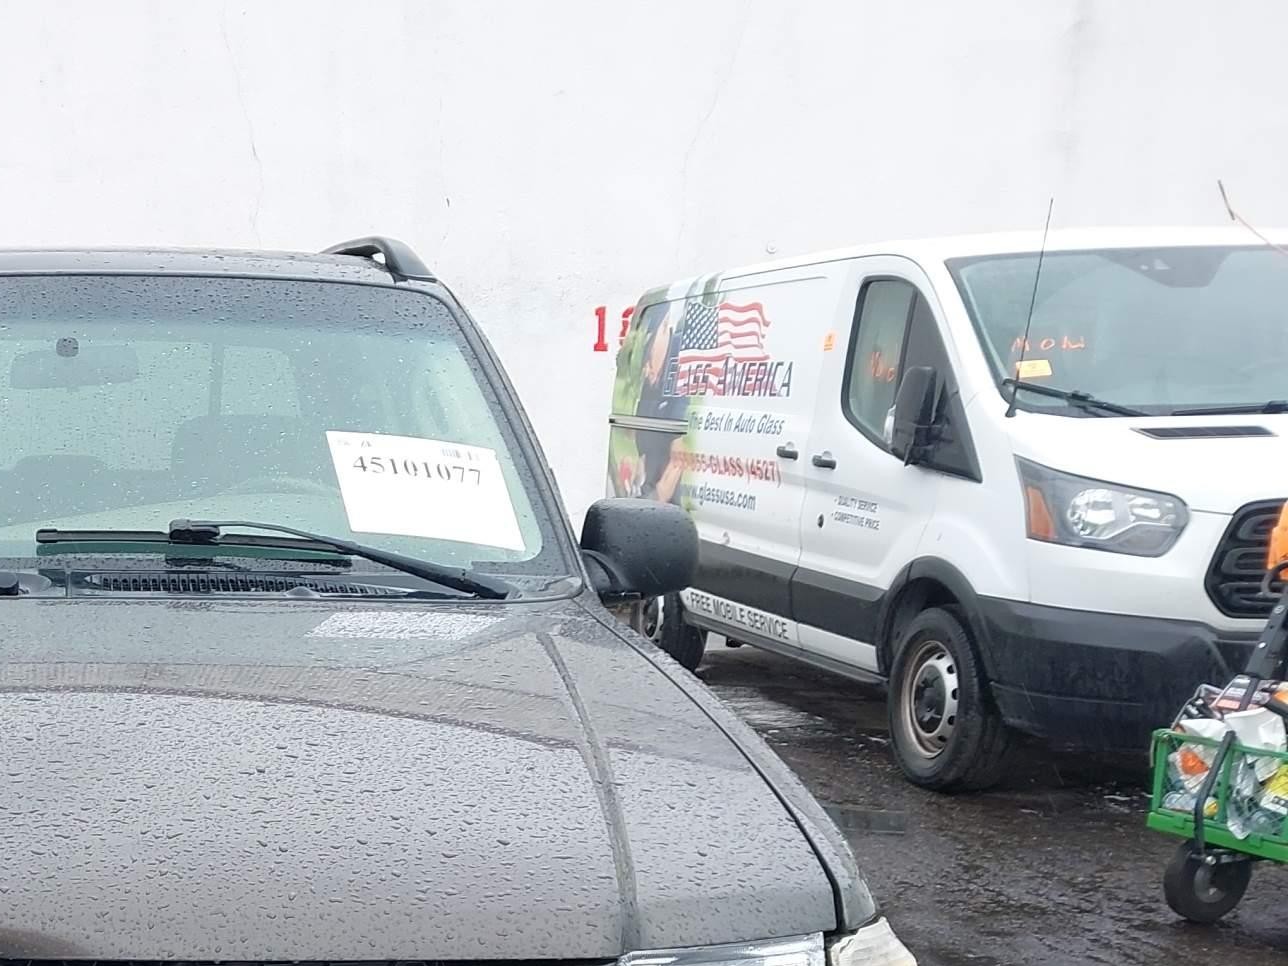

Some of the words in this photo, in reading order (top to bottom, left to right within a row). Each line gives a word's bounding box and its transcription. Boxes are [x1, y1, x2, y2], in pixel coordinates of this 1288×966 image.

[716, 354, 794, 398] AMERICA
[704, 411, 723, 431] Best
[723, 412, 732, 432] In
[733, 412, 757, 434] Auto
[757, 413, 785, 436] Glass
[352, 455, 481, 486] 45101077
[690, 591, 713, 613] FREE
[712, 598, 747, 625] MOBILE
[746, 609, 790, 640] SERVICE
